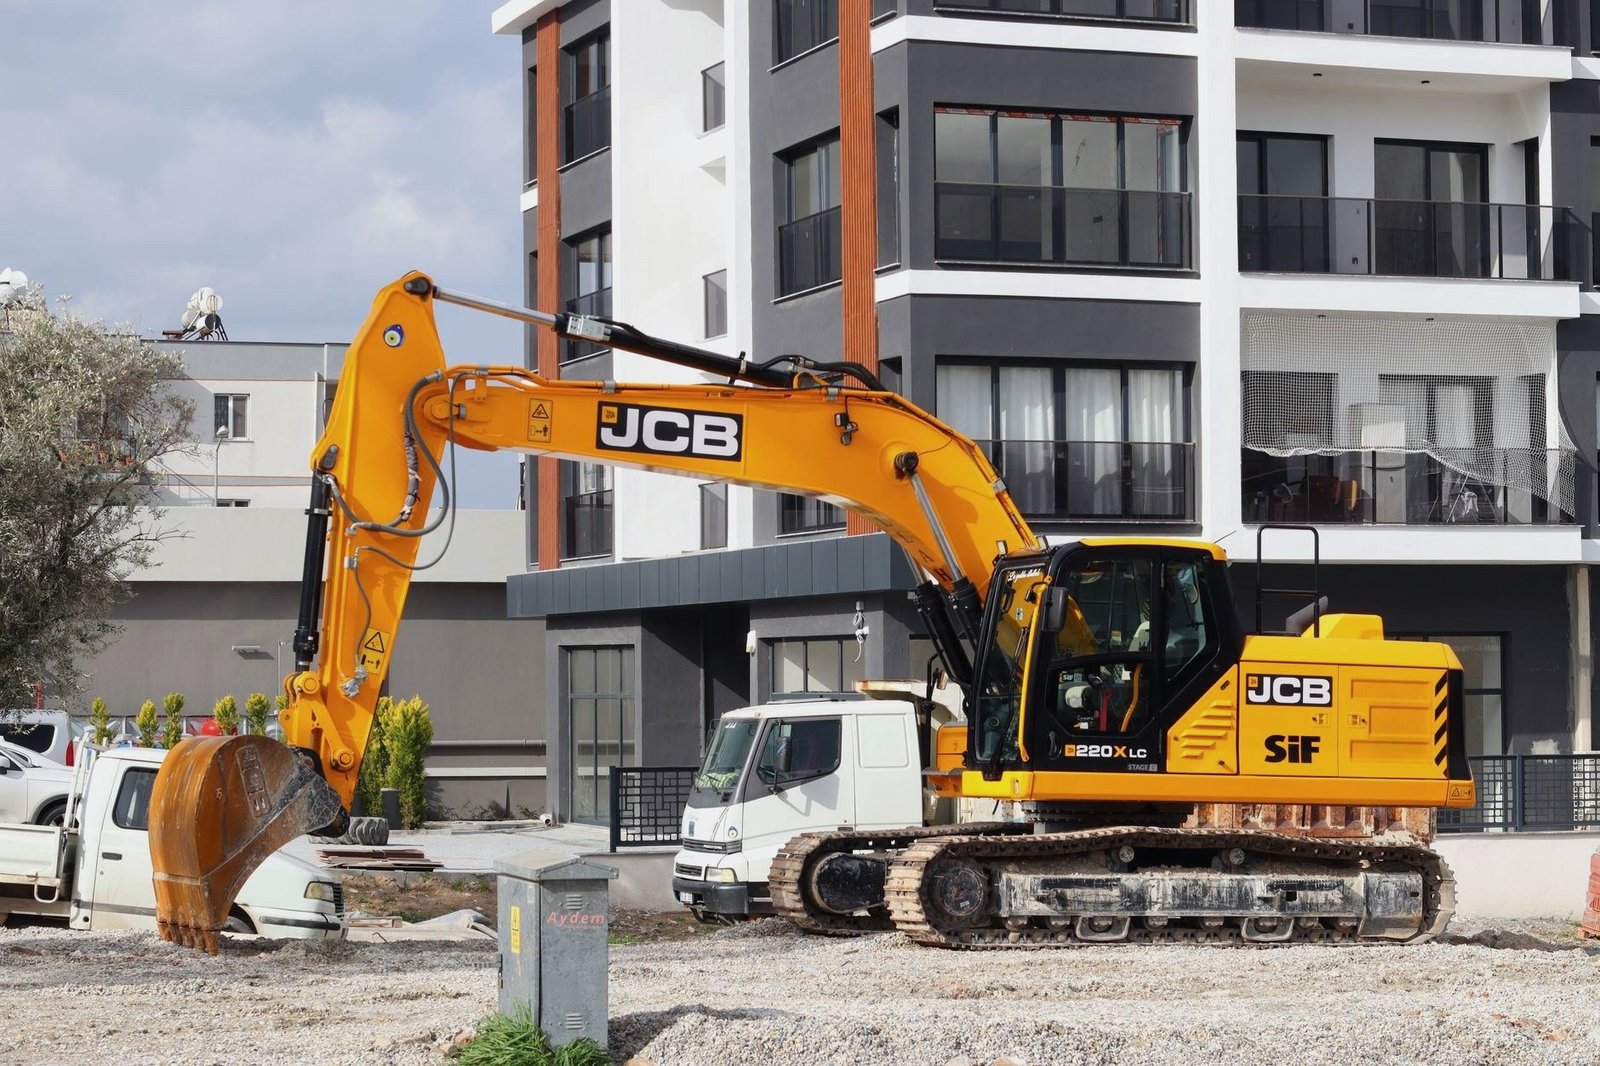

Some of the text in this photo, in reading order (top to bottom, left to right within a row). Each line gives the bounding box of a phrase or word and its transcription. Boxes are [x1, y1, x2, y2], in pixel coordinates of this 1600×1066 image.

[600, 407, 739, 457] JCB
[1247, 676, 1331, 705] JCB
[1129, 749, 1147, 758] LC
[1264, 735, 1321, 763] SiF
[547, 911, 605, 926] Aydem
